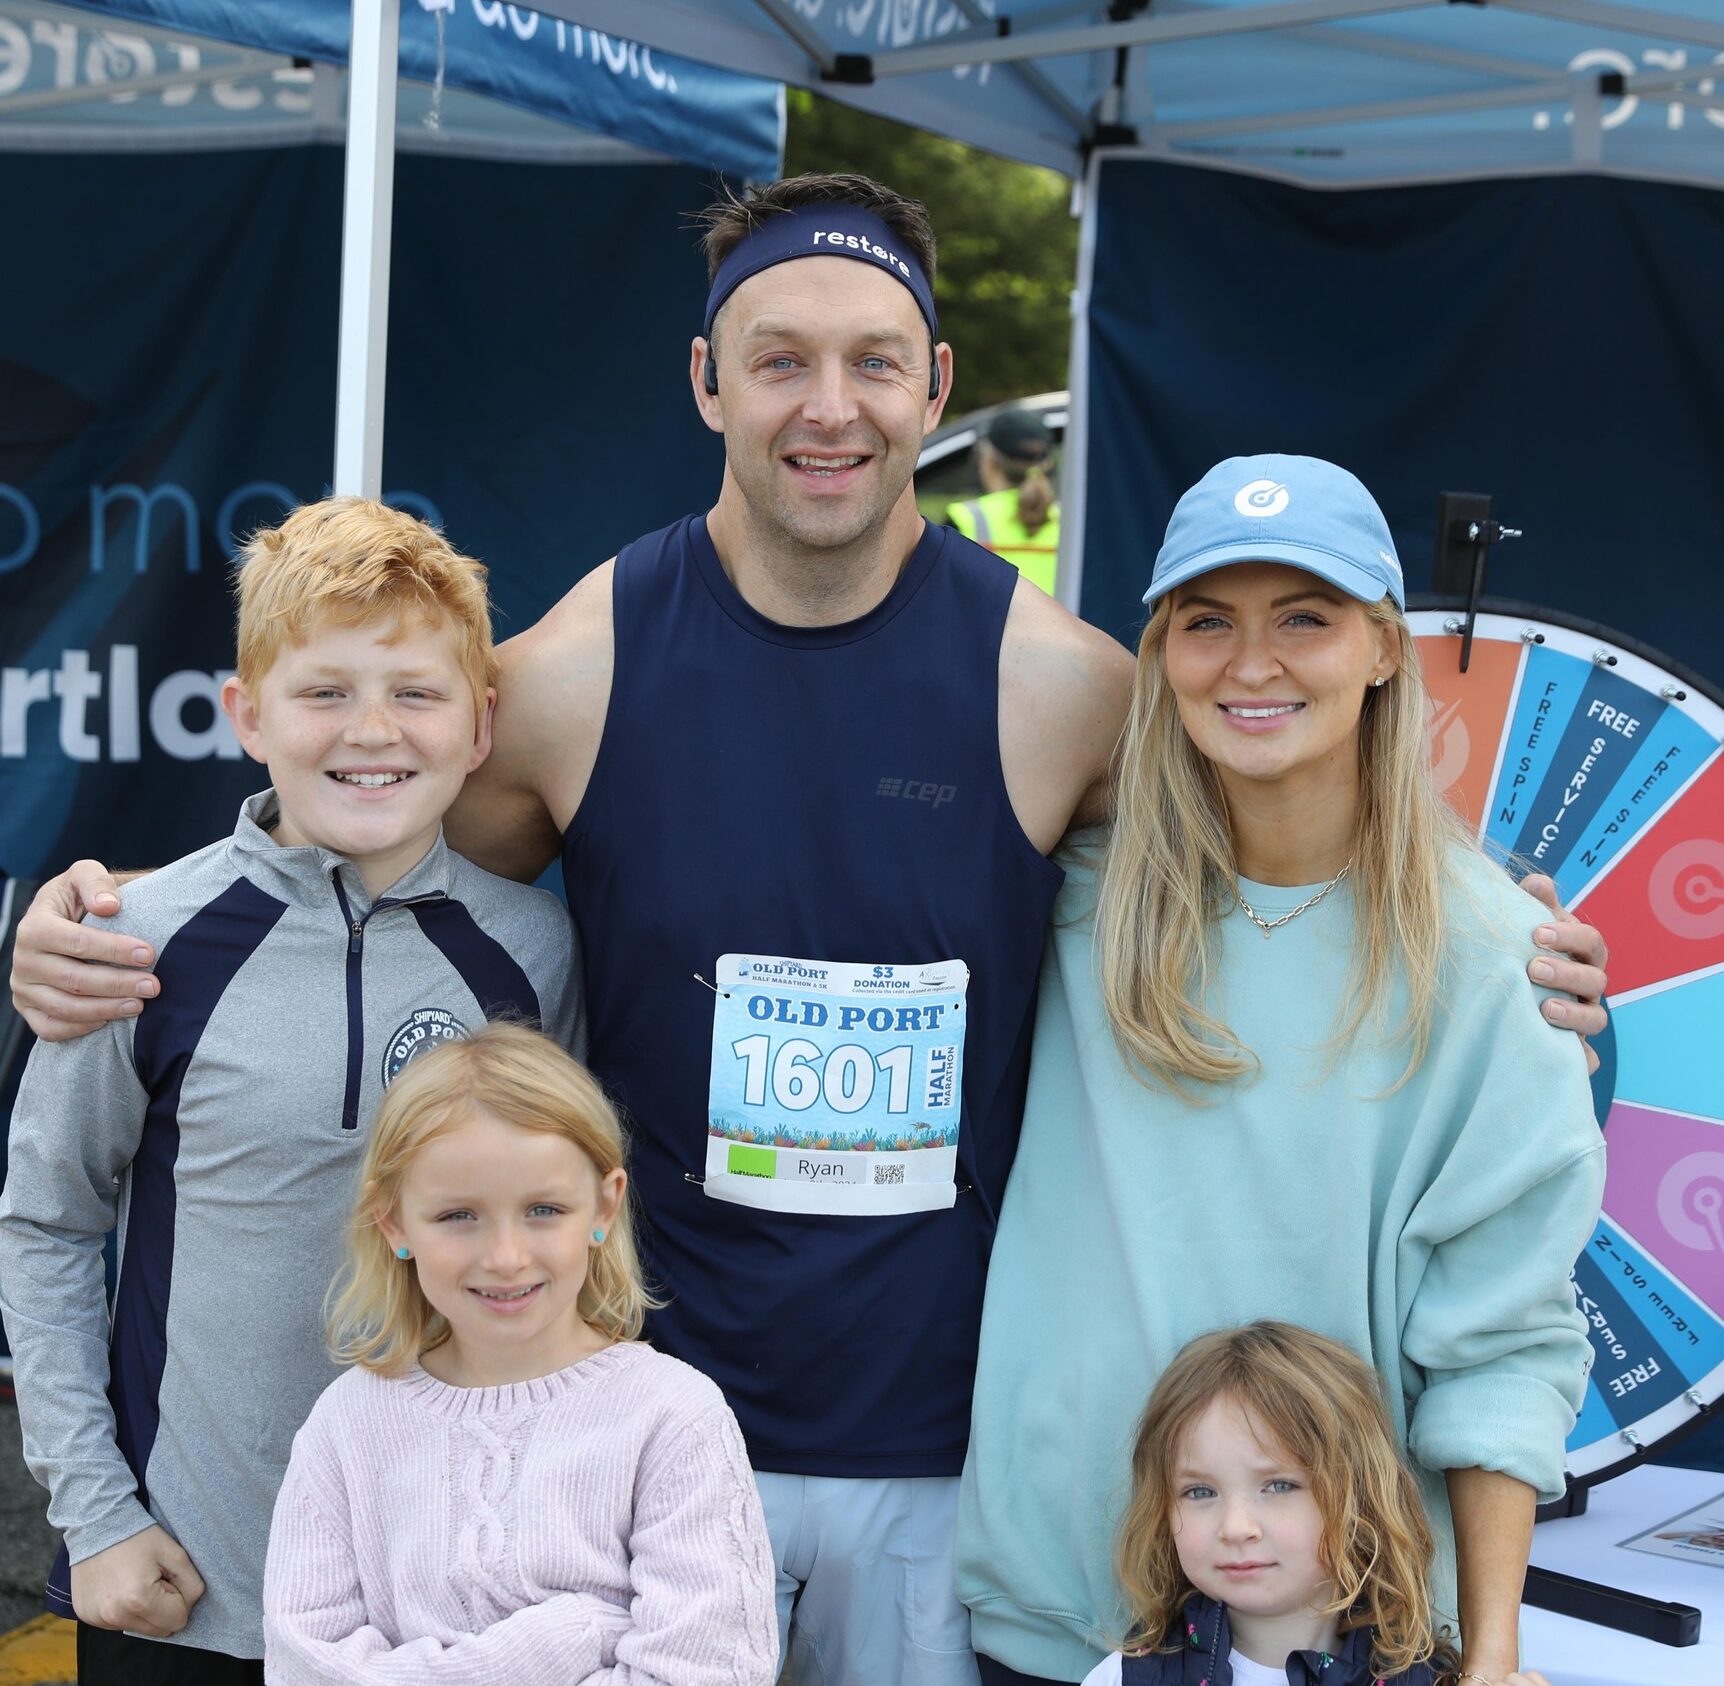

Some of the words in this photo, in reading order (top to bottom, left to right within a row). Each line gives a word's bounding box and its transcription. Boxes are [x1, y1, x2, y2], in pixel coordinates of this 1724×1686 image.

[813, 231, 911, 273] restore
[1527, 681, 1557, 749] FREE
[1587, 699, 1641, 739] FREE
[903, 780, 958, 809] cep
[1500, 757, 1532, 825] SPIN
[1631, 747, 1681, 805] FREE
[1533, 737, 1606, 859] SERVICE
[1580, 808, 1630, 868] SPIN
[752, 975, 770, 983] HALF
[772, 978, 812, 988] MARATHON
[753, 963, 784, 975] OLD
[788, 966, 829, 980] PORT
[854, 979, 911, 989] DONATION
[872, 966, 894, 980] $3
[414, 1010, 451, 1025] SHIPYARD
[747, 995, 829, 1027] OLD
[837, 1005, 945, 1032] PORT
[395, 1026, 426, 1059] OLD
[731, 1033, 913, 1114] 1601
[928, 1049, 946, 1107] HALF
[944, 1046, 955, 1106] MARATHON
[798, 1159, 844, 1179] Ryan
[1594, 1235, 1647, 1288] SPIN
[1569, 1266, 1627, 1360] SERVI
[1649, 1292, 1700, 1345] FREE
[1609, 1357, 1662, 1398] FREE
